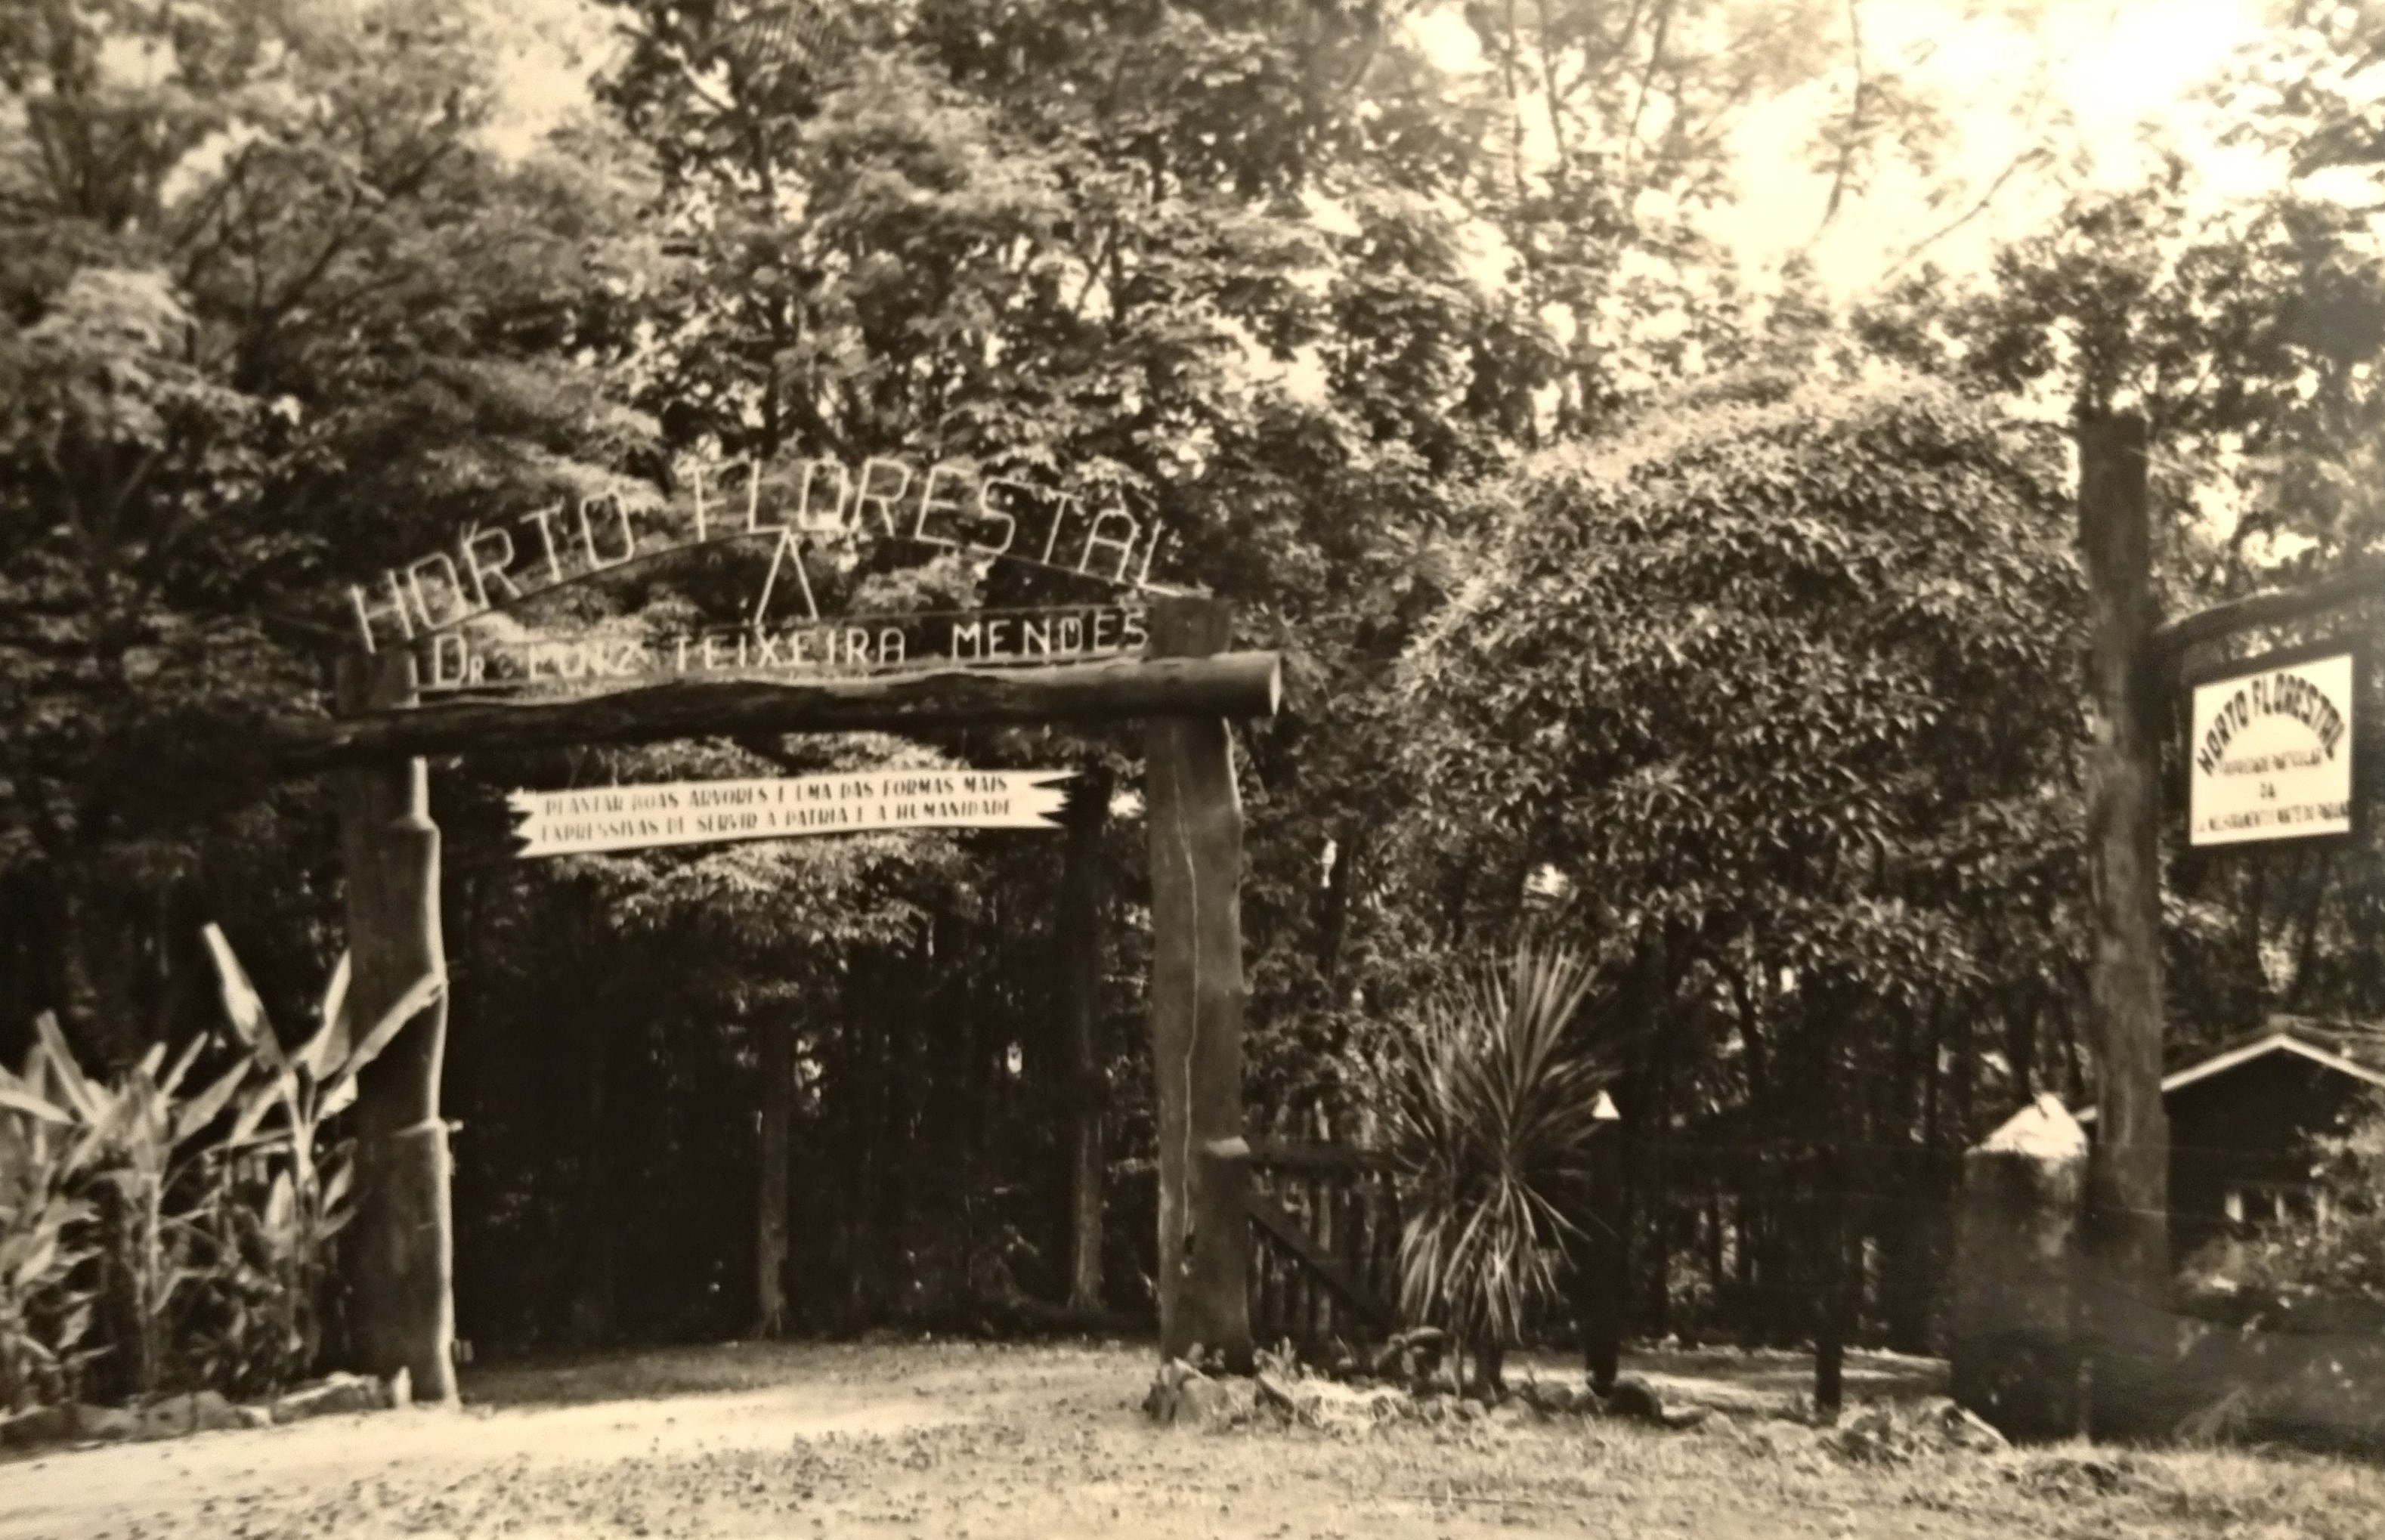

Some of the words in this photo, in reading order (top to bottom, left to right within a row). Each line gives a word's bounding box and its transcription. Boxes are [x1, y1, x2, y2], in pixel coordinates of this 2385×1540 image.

[351, 487, 634, 654] HORTO
[686, 457, 1182, 597] FLORESTAL
[675, 628, 907, 669] TEIXEIRA
[952, 612, 1150, 660] MENDES
[2197, 690, 2250, 777] HORTO
[544, 794, 623, 816] PLANTAR
[840, 779, 874, 799] DAS
[883, 777, 954, 797] FORMAS
[964, 775, 1007, 794] MAIS
[896, 798, 1011, 820] HUMANIDADE
